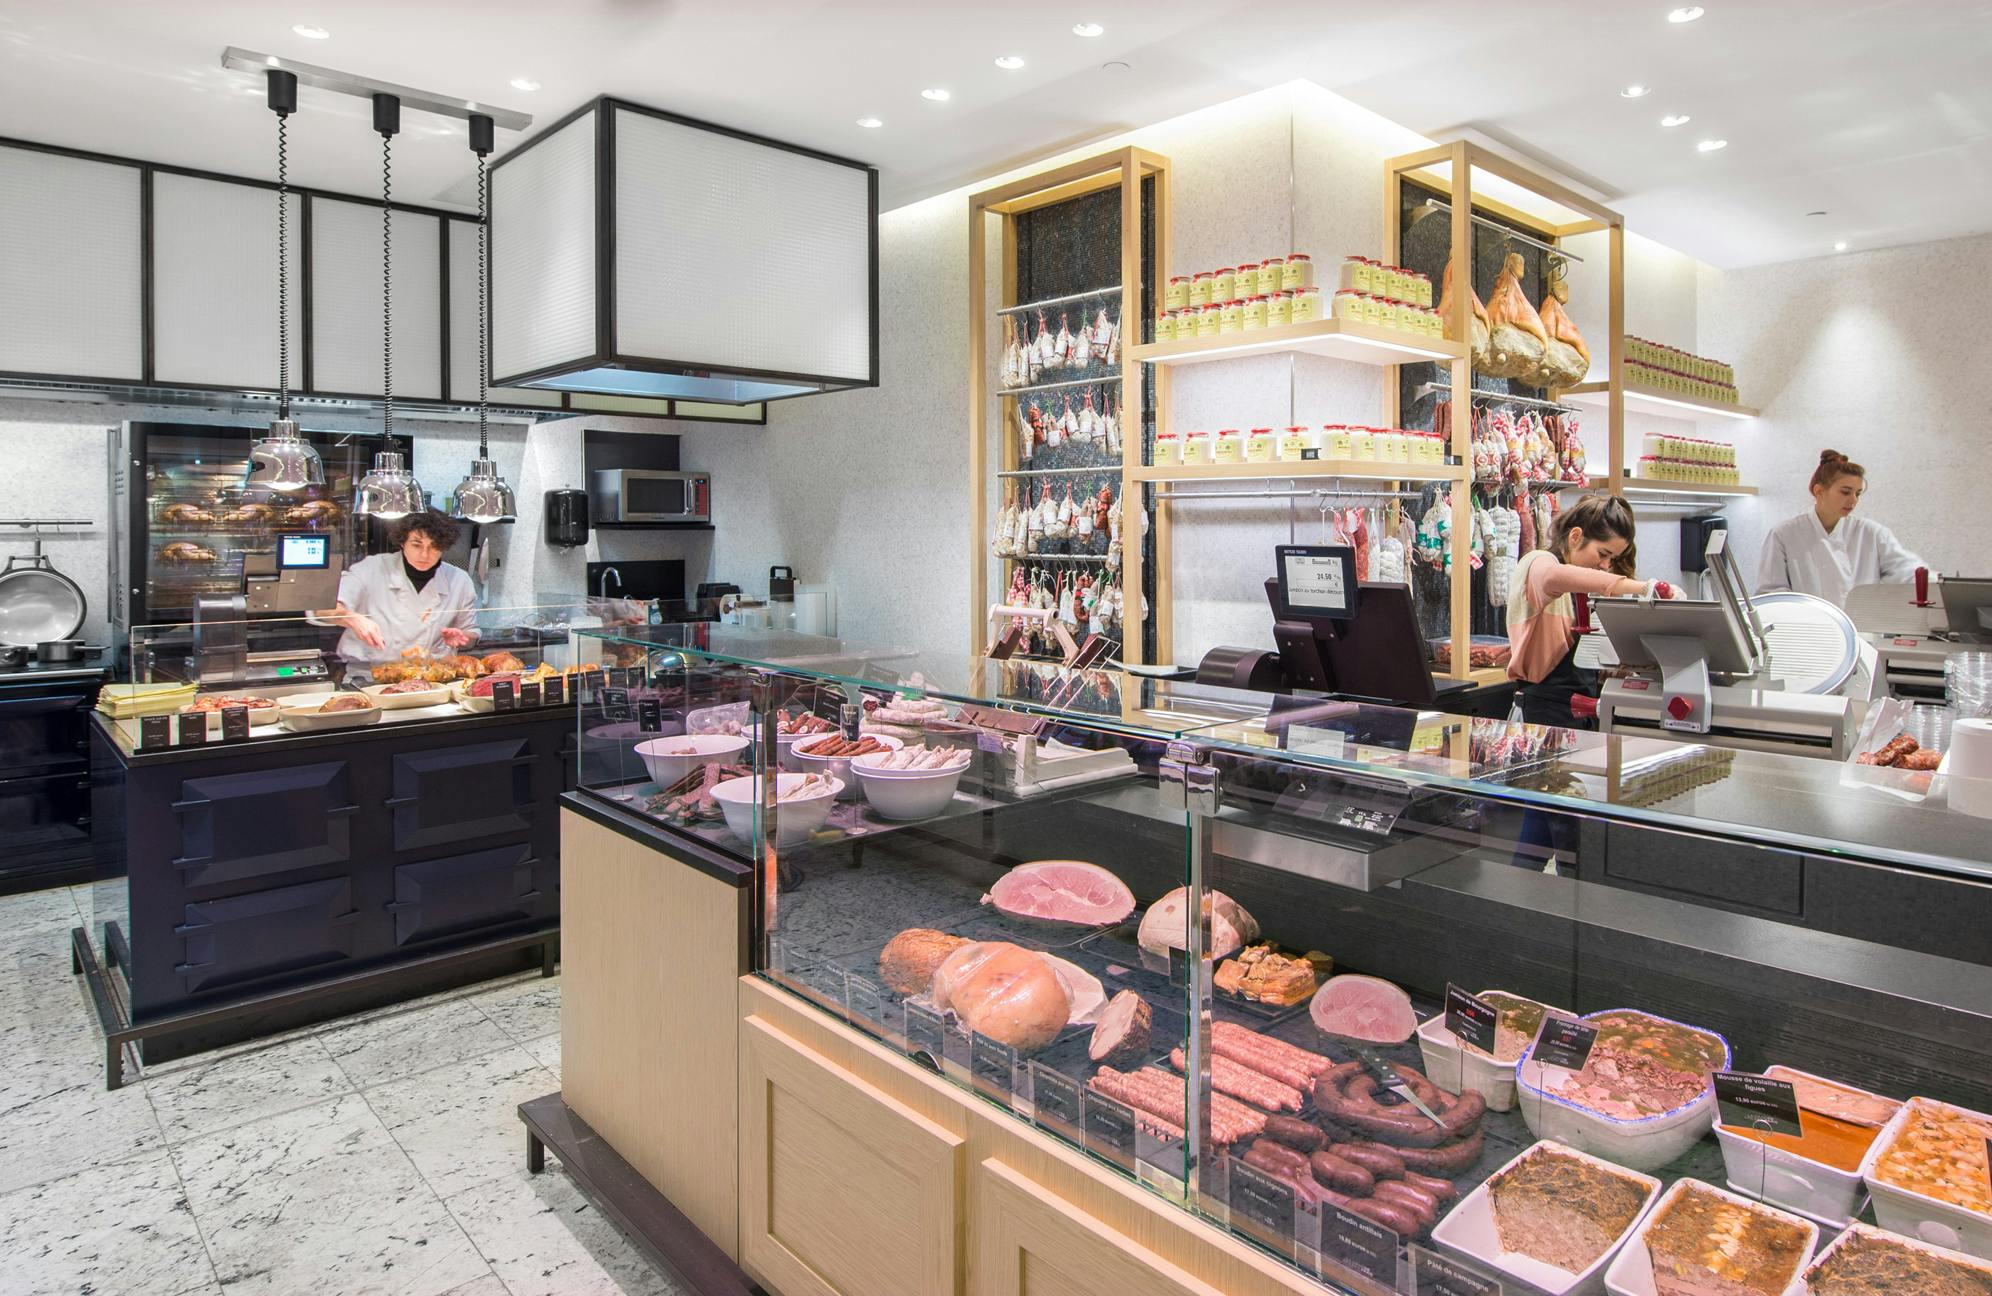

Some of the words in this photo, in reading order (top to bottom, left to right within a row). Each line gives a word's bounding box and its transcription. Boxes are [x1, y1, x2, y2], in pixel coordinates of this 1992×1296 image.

[1471, 1001, 1496, 1018] Bourgogne
[1716, 1073, 1743, 1083] Mousse
[1743, 1076, 1753, 1084] de
[1754, 1078, 1778, 1088] volaille
[1779, 1080, 1792, 1090] aux
[1744, 1083, 1767, 1093] figues
[1336, 1210, 1359, 1228] Boudin
[1358, 1222, 1383, 1240] antillais
[1427, 1258, 1443, 1272] Pâté
[1443, 1266, 1453, 1277] de
[1453, 1270, 1490, 1293] campagne
